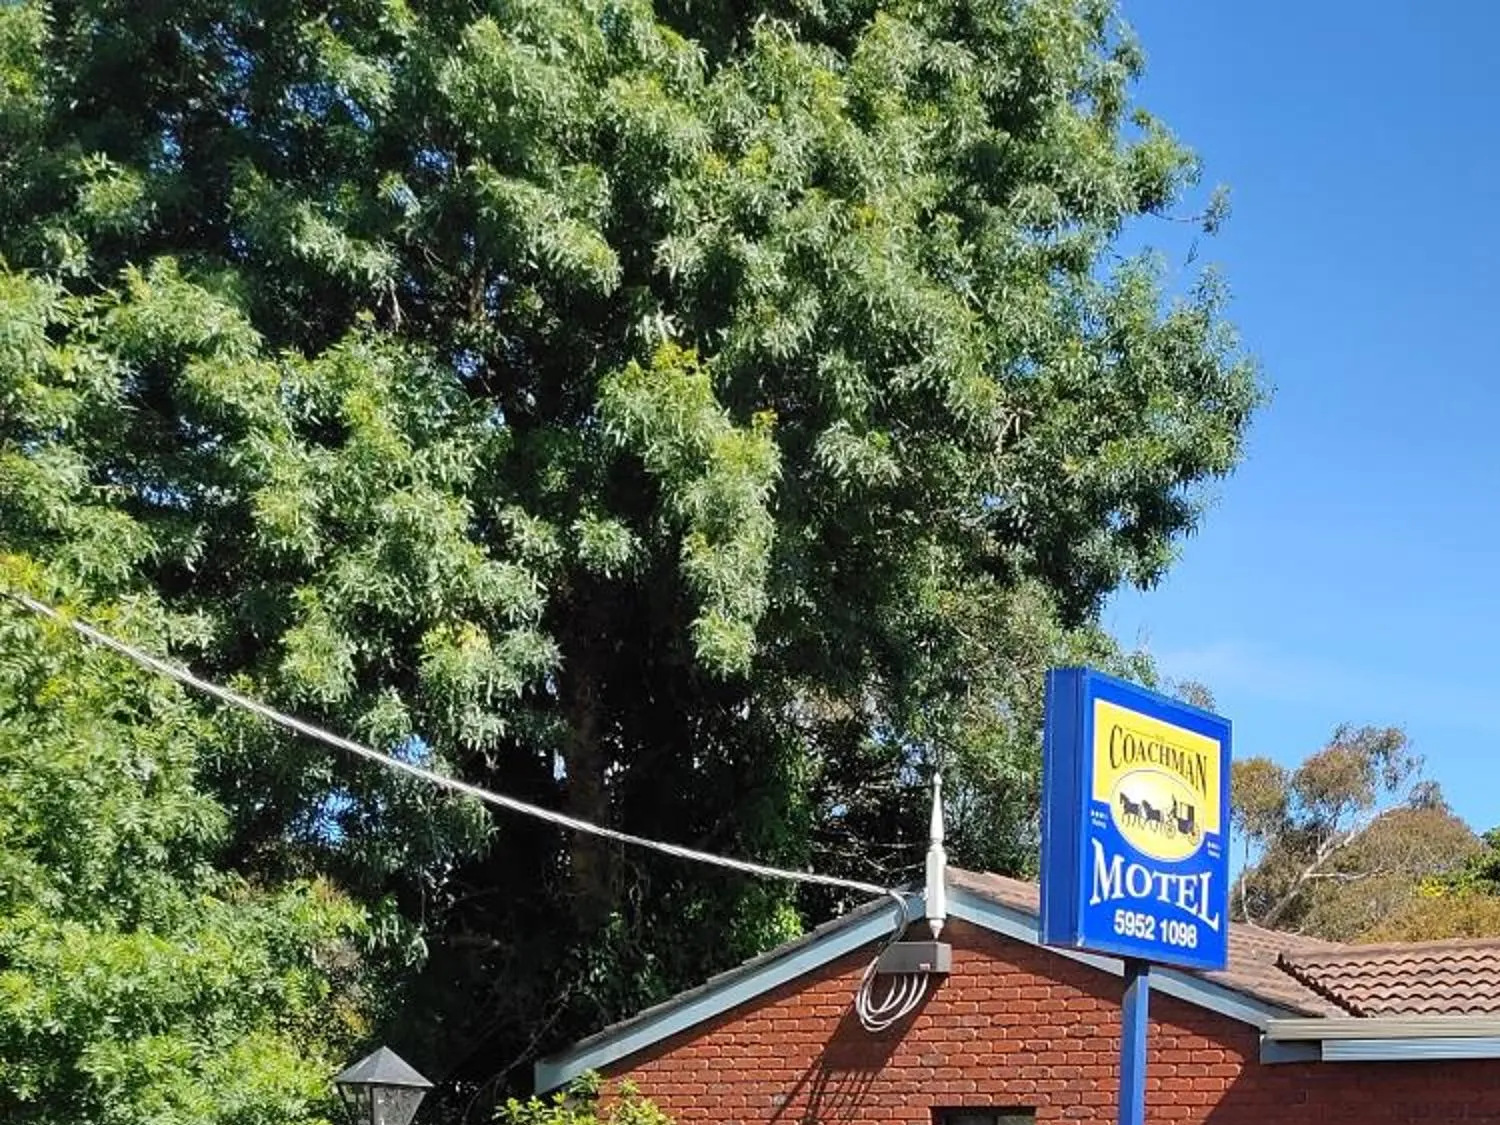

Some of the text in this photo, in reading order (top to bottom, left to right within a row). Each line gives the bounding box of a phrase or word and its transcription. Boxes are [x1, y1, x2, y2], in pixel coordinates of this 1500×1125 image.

[1109, 724, 1207, 799] COACHMAN
[1090, 838, 1219, 932] MOTEL
[1113, 909, 1197, 948] 5952 1098
